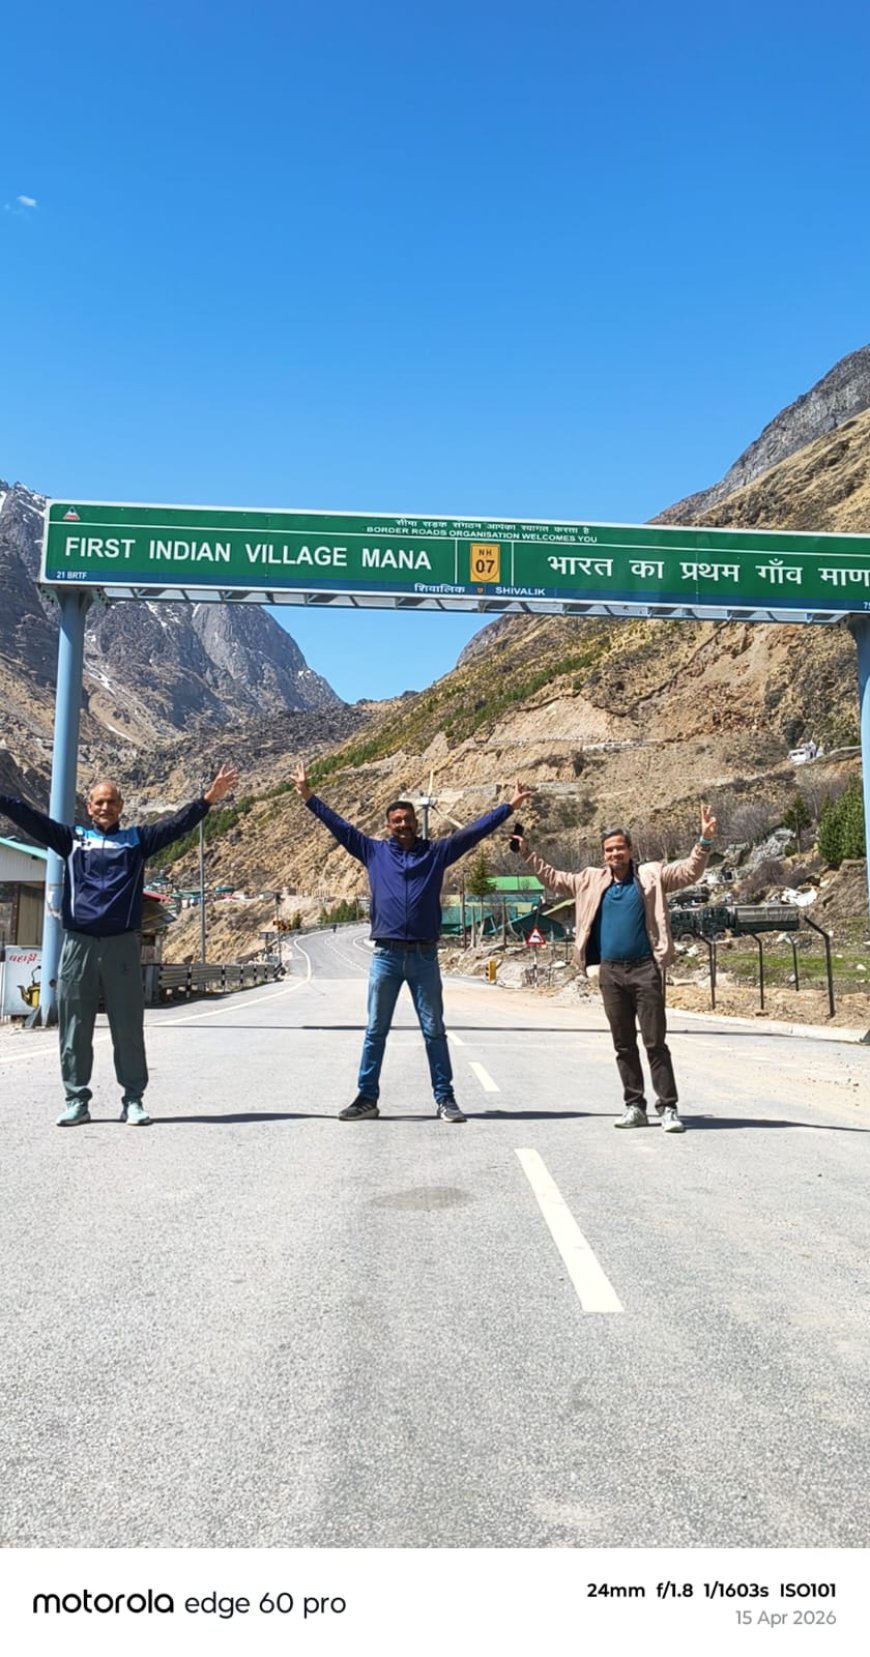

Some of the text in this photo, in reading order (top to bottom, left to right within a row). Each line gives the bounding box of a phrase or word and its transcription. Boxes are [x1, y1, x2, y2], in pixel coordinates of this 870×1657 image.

[366, 526, 409, 535] BORDER
[449, 530, 520, 539] ORGANISATION
[521, 533, 576, 542] WELCOMES
[396, 518, 417, 527] सीमा
[554, 526, 578, 534] करता
[583, 526, 590, 535] है
[65, 536, 432, 570] FIRST INDIAN VILLAGE MANA
[478, 549, 492, 557] NH
[475, 559, 495, 574] 07
[547, 555, 870, 587] भारत का प्रथम गाँव माण
[56, 570, 88, 580] 21 BRTF
[414, 582, 465, 593] शिवालिक
[495, 586, 546, 596] SHIVALIK
